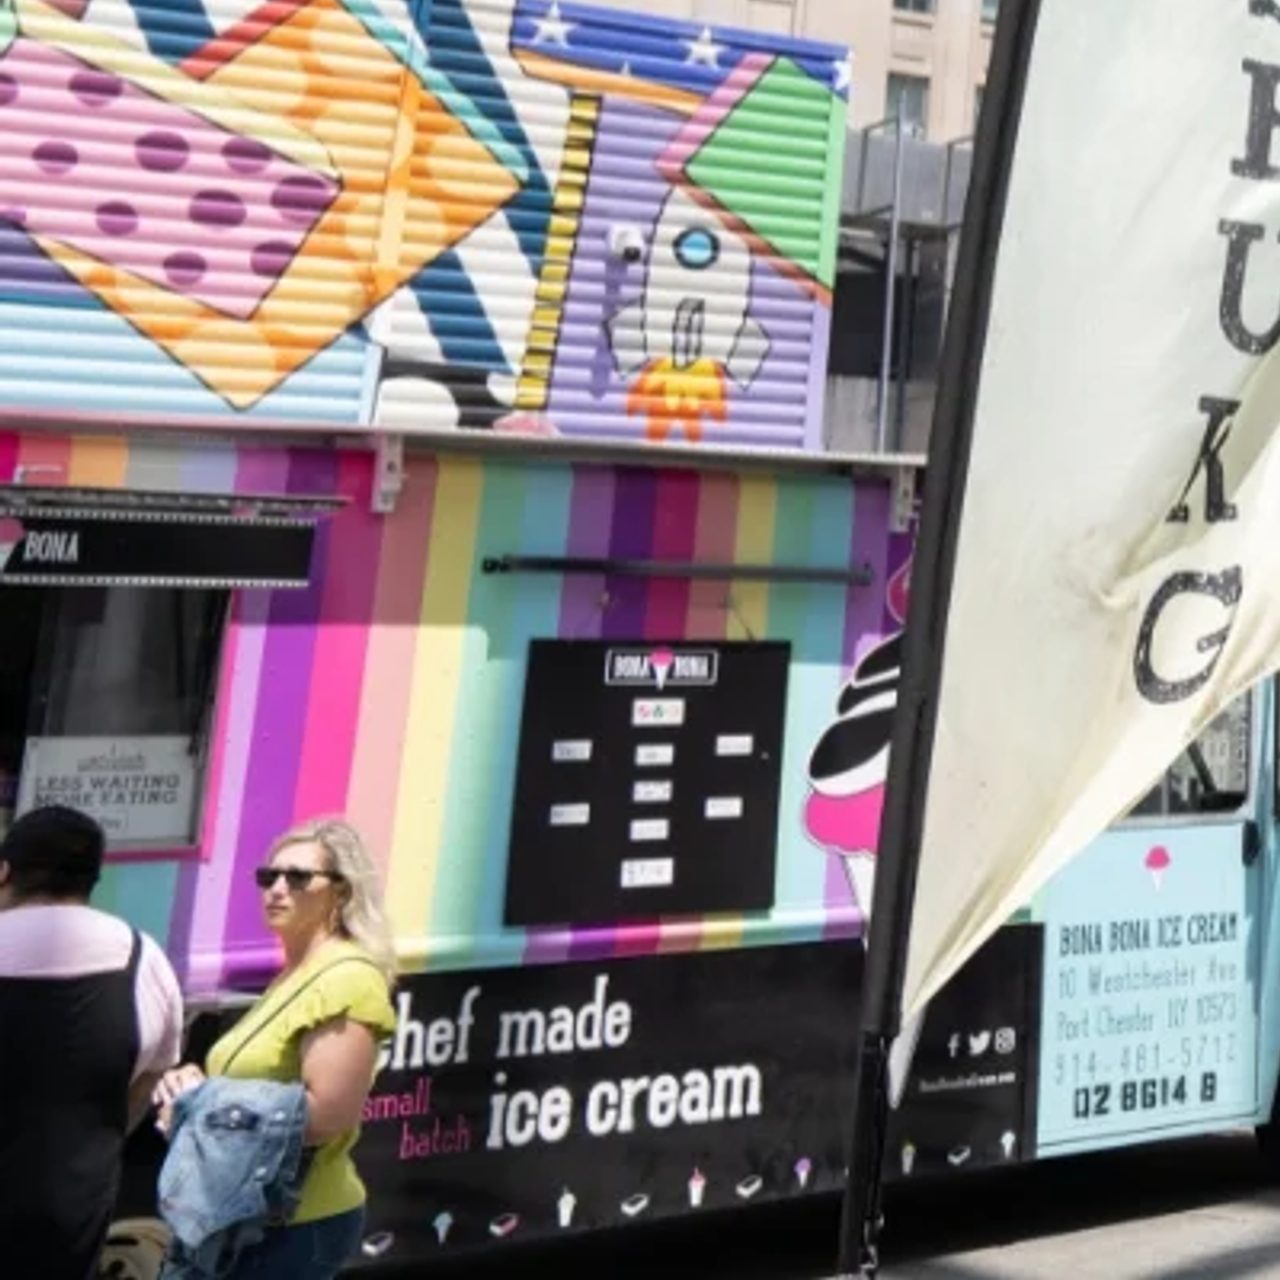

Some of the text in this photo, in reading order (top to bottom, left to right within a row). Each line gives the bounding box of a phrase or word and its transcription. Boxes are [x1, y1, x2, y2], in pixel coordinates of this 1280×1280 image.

[23, 531, 79, 562] BONA
[1059, 912, 1238, 957] BONA BONA ICE CREAM
[495, 974, 632, 1058] made
[361, 1077, 431, 1121] small
[487, 1061, 762, 1151] ice cream
[399, 1120, 471, 1160] batch
